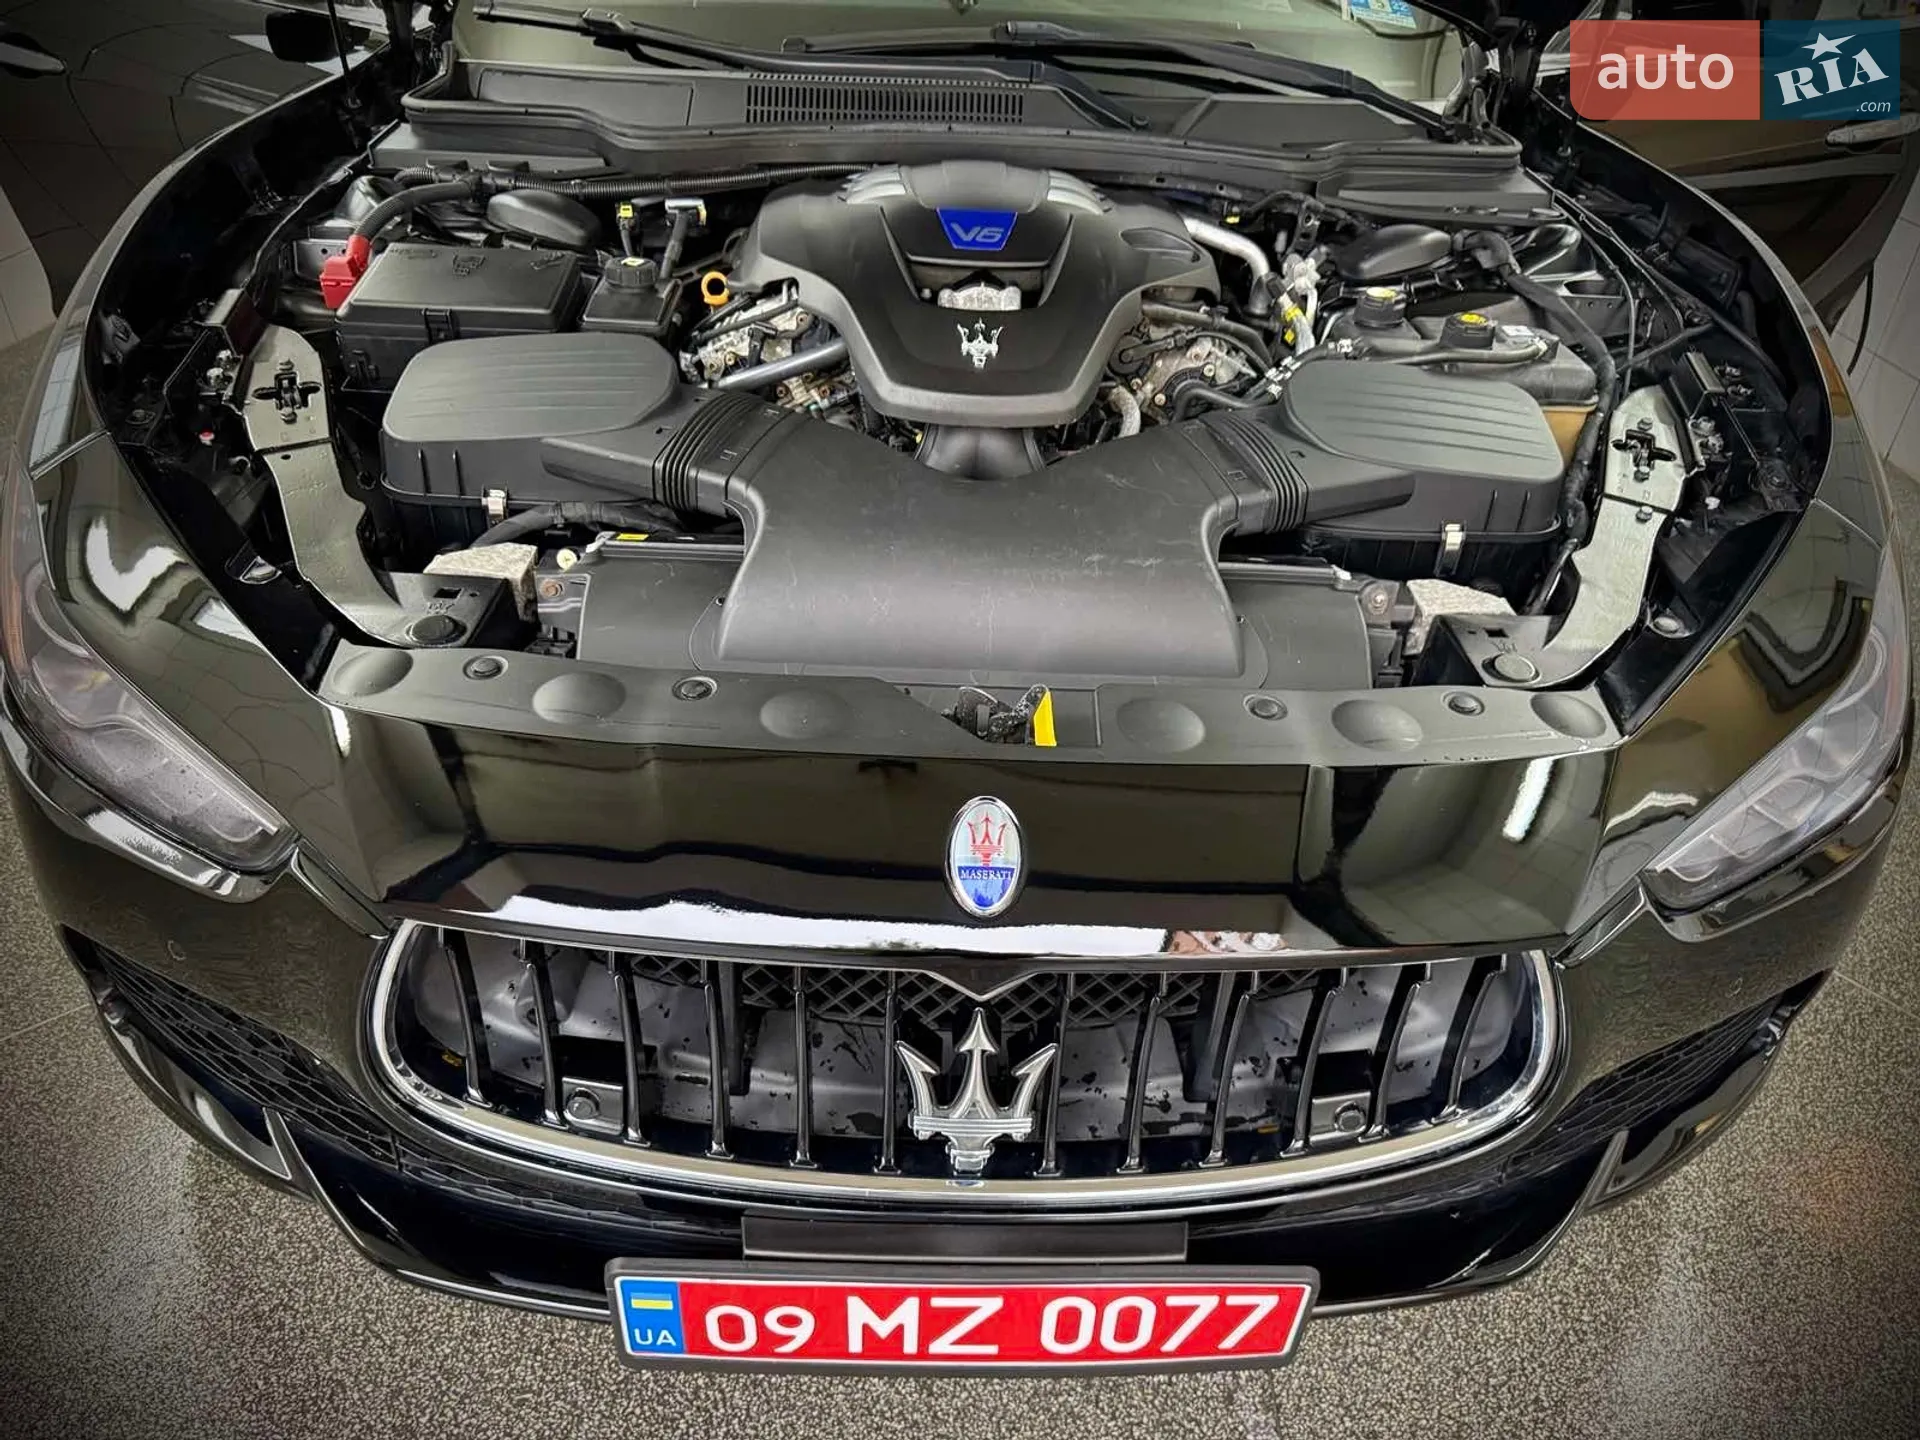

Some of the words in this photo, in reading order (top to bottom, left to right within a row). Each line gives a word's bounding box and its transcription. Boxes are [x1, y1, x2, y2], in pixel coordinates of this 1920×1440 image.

[950, 222, 1004, 243] V6
[960, 869, 1012, 880] MASERATI
[705, 1305, 815, 1353] 09
[847, 1296, 1004, 1354] MZ
[1040, 1295, 1280, 1354] 0077
[634, 1328, 676, 1346] UA
